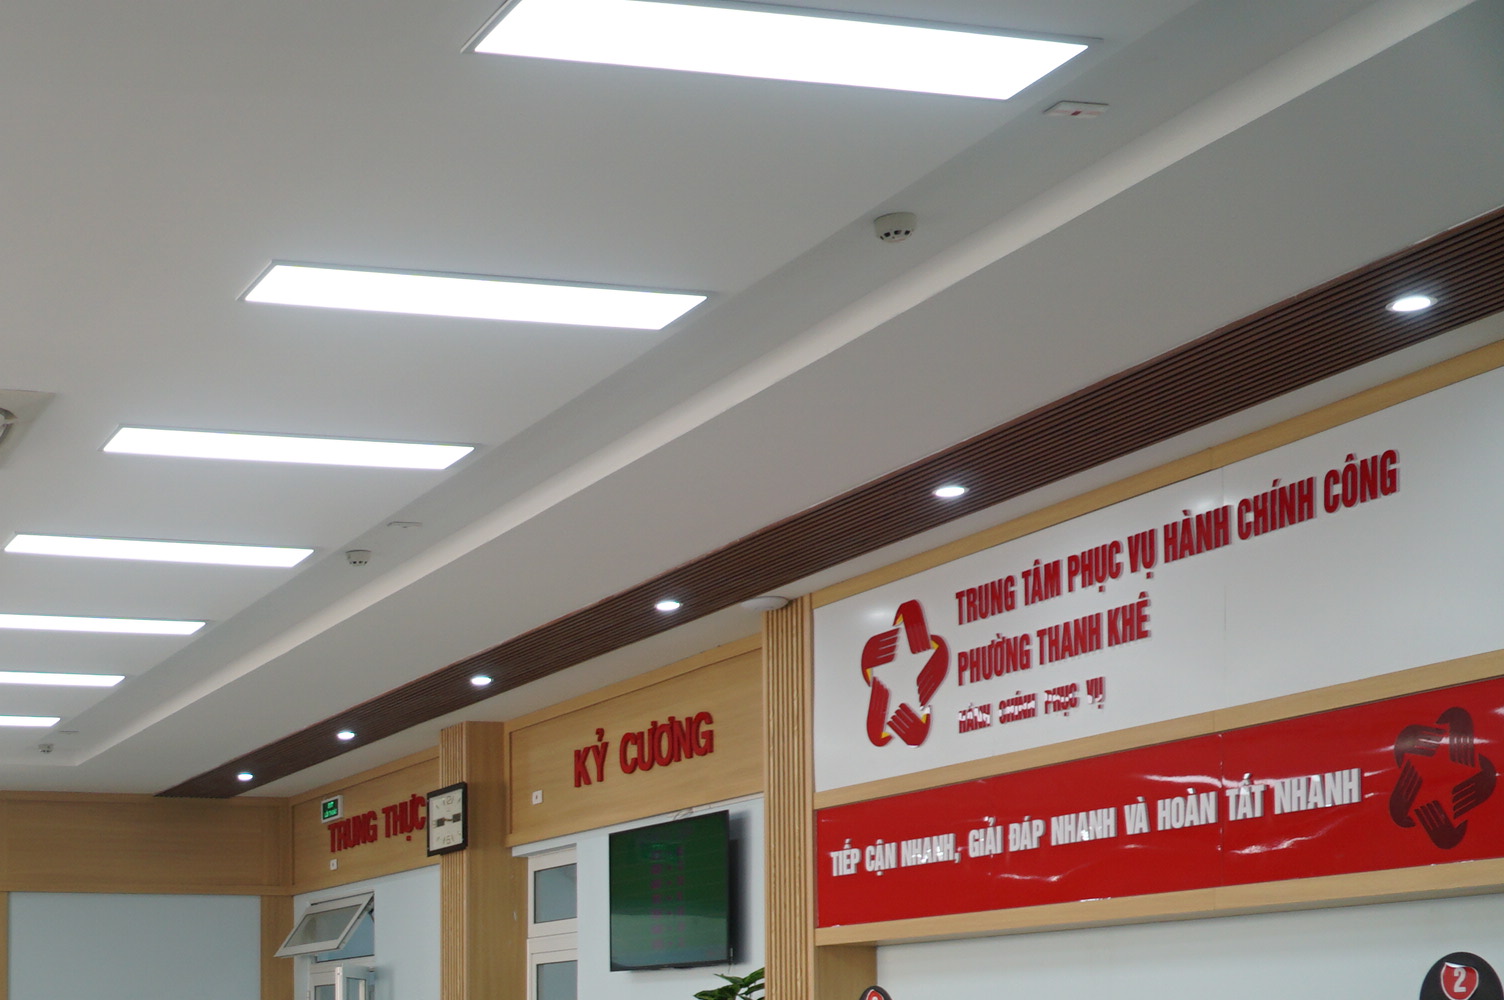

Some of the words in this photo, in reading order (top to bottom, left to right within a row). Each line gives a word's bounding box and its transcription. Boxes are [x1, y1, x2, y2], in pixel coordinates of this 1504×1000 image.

[955, 574, 1016, 625] TRUNG
[1021, 559, 1062, 606] TÂM
[1067, 540, 1123, 593] PHỤC
[1127, 528, 1158, 580] VỤ
[1163, 505, 1232, 563] HÀNH
[1237, 476, 1317, 540] CHÍNH
[1323, 449, 1400, 514] CÔNG
[957, 633, 1031, 686] PHƯỜNG
[1036, 612, 1103, 665] THANH
[1107, 591, 1151, 647] KHÊ
[574, 727, 609, 788] KỶ
[619, 711, 714, 774] CƯƠNG
[327, 810, 378, 852] TRUNG
[382, 793, 427, 842] THỰC
[830, 838, 860, 877] TIẾP
[864, 839, 897, 876] CẬN
[900, 832, 961, 864] NHANH,
[968, 816, 1004, 858] GIẢI
[1008, 815, 1045, 852] ĐÁP
[1050, 806, 1117, 847] NHANH
[1123, 796, 1151, 835] VÀ
[1157, 787, 1218, 832] HOÀN
[1225, 772, 1267, 821] TẤT
[1272, 767, 1362, 815] NHANH
[1453, 967, 1467, 993] 2
